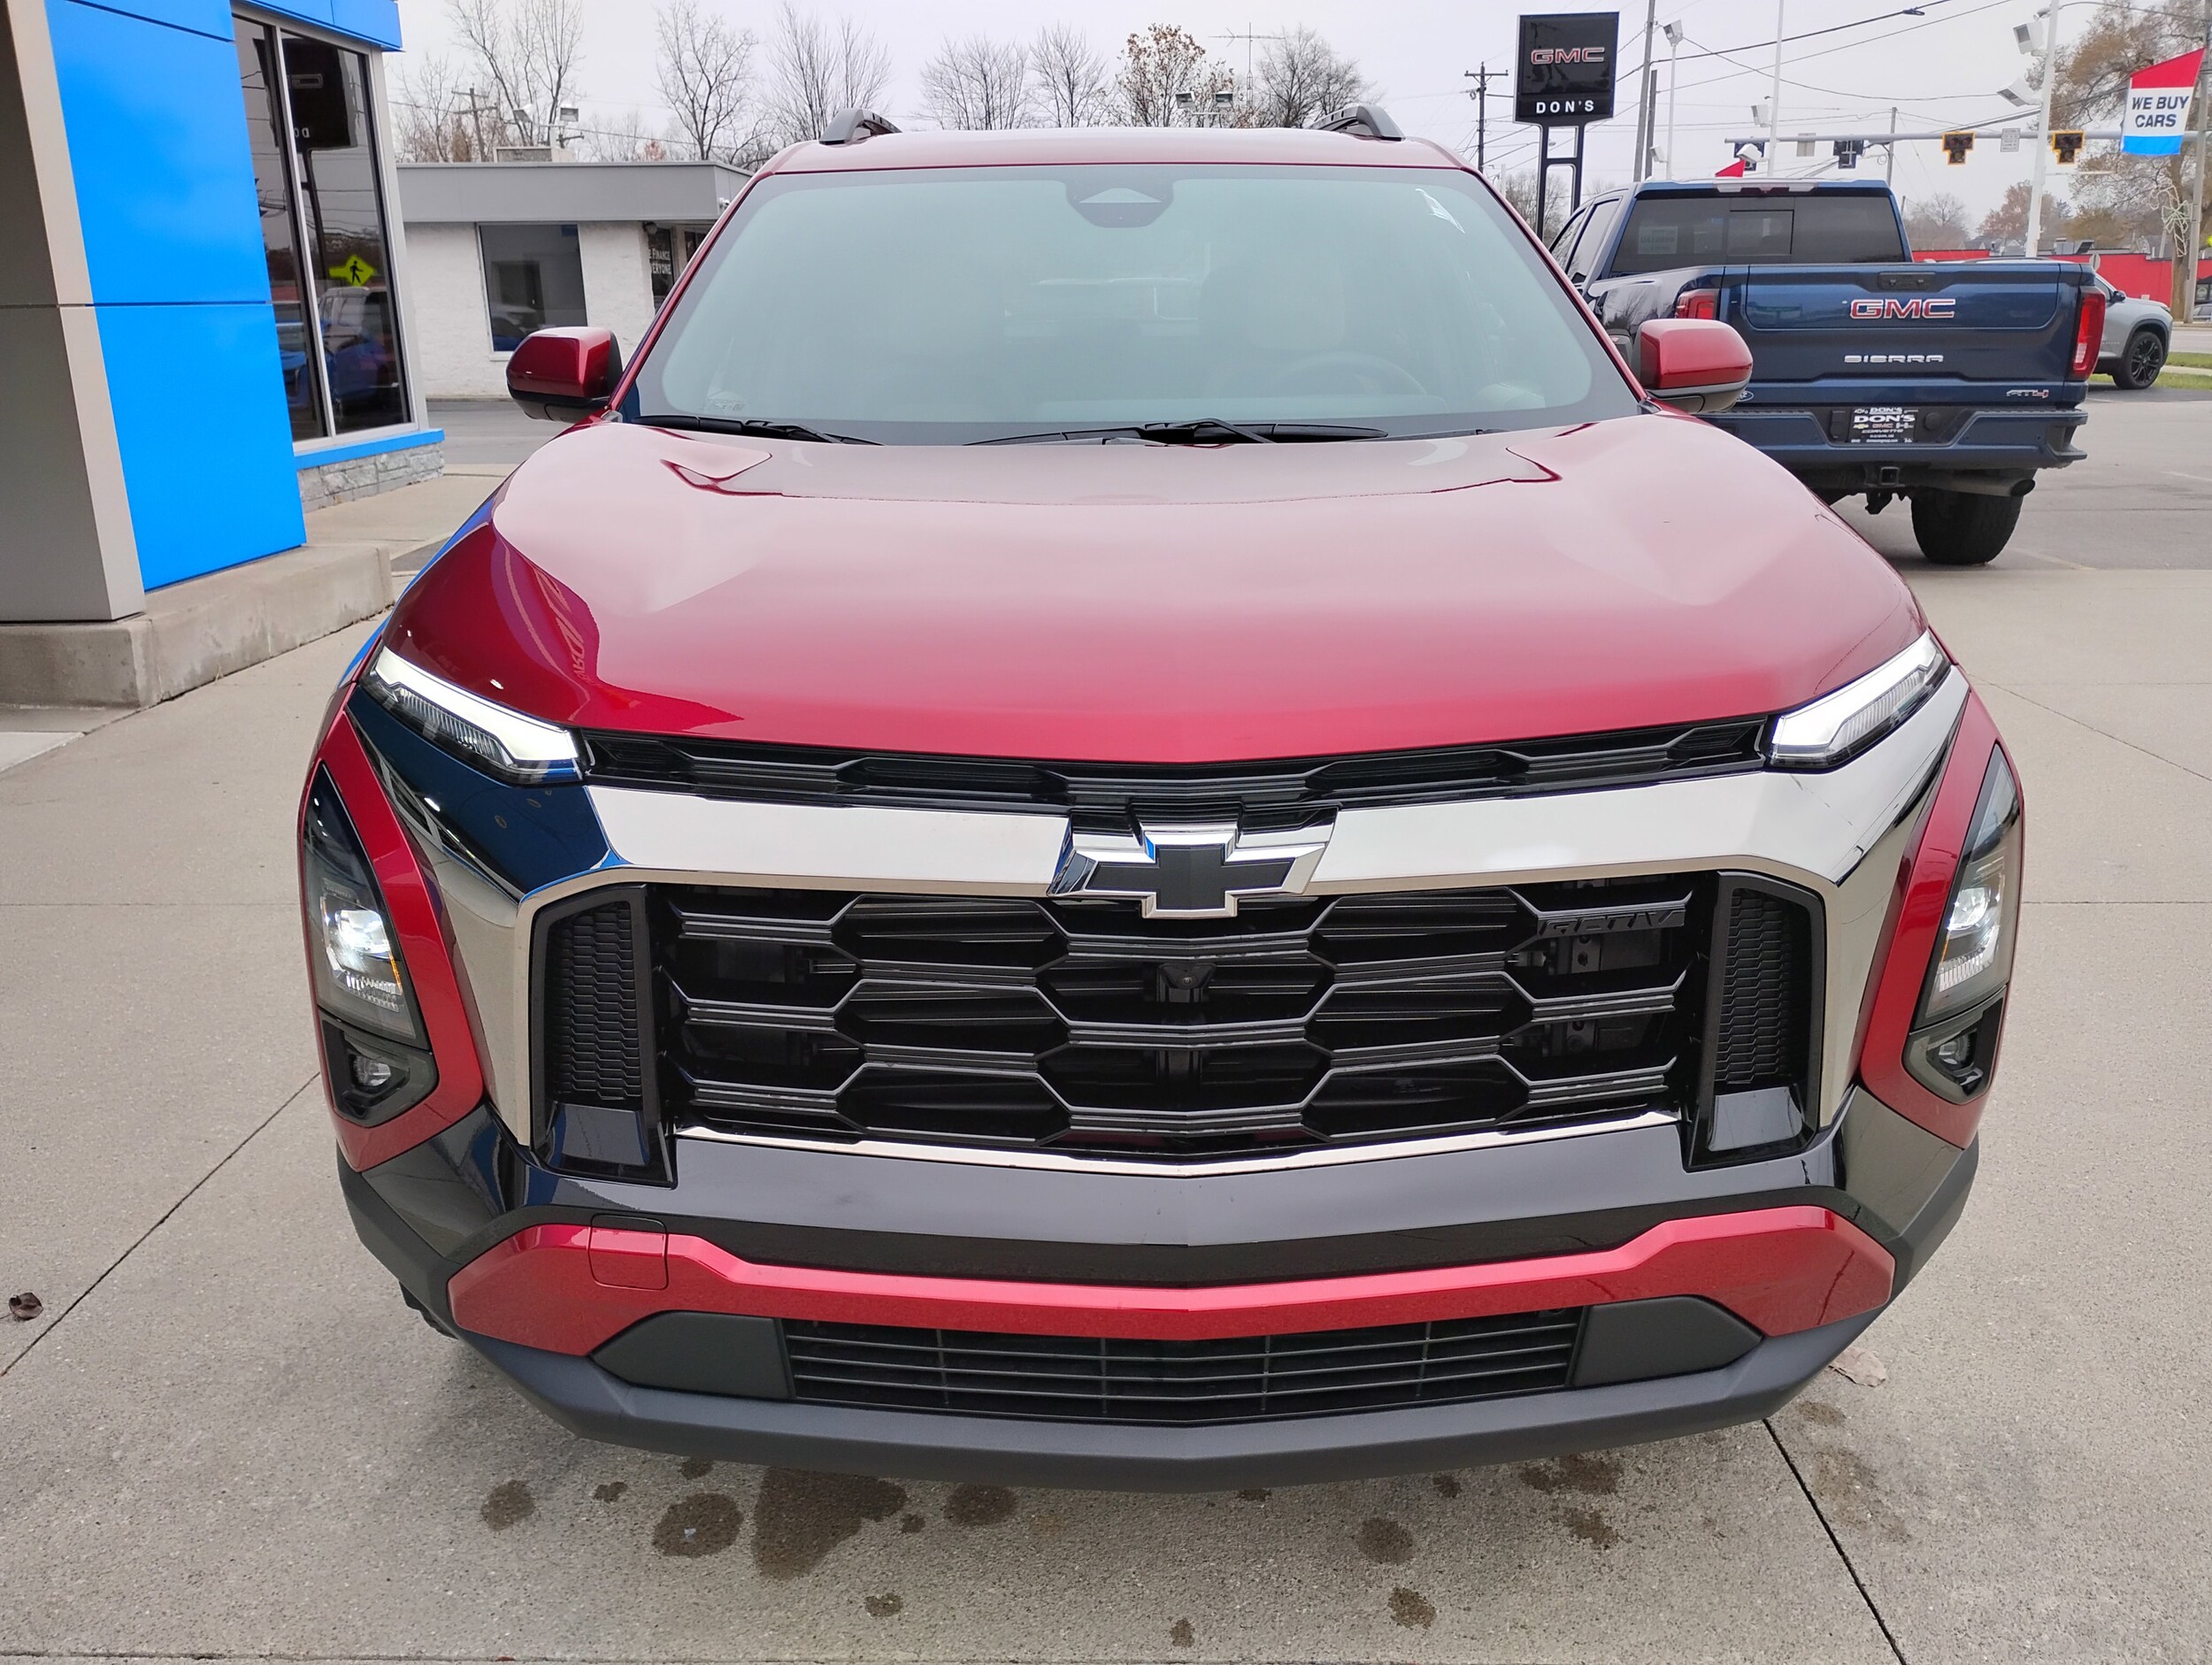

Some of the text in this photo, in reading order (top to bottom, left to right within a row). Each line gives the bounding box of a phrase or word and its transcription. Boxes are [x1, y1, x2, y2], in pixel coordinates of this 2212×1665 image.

[1531, 47, 1605, 65] GMC
[1536, 100, 1594, 113] DON'S
[2131, 96, 2189, 110] WE BUY
[2135, 114, 2177, 127] CARS
[1850, 299, 1955, 319] GMC
[1844, 355, 1944, 364] SIERRA
[1854, 414, 1916, 423] DON'S
